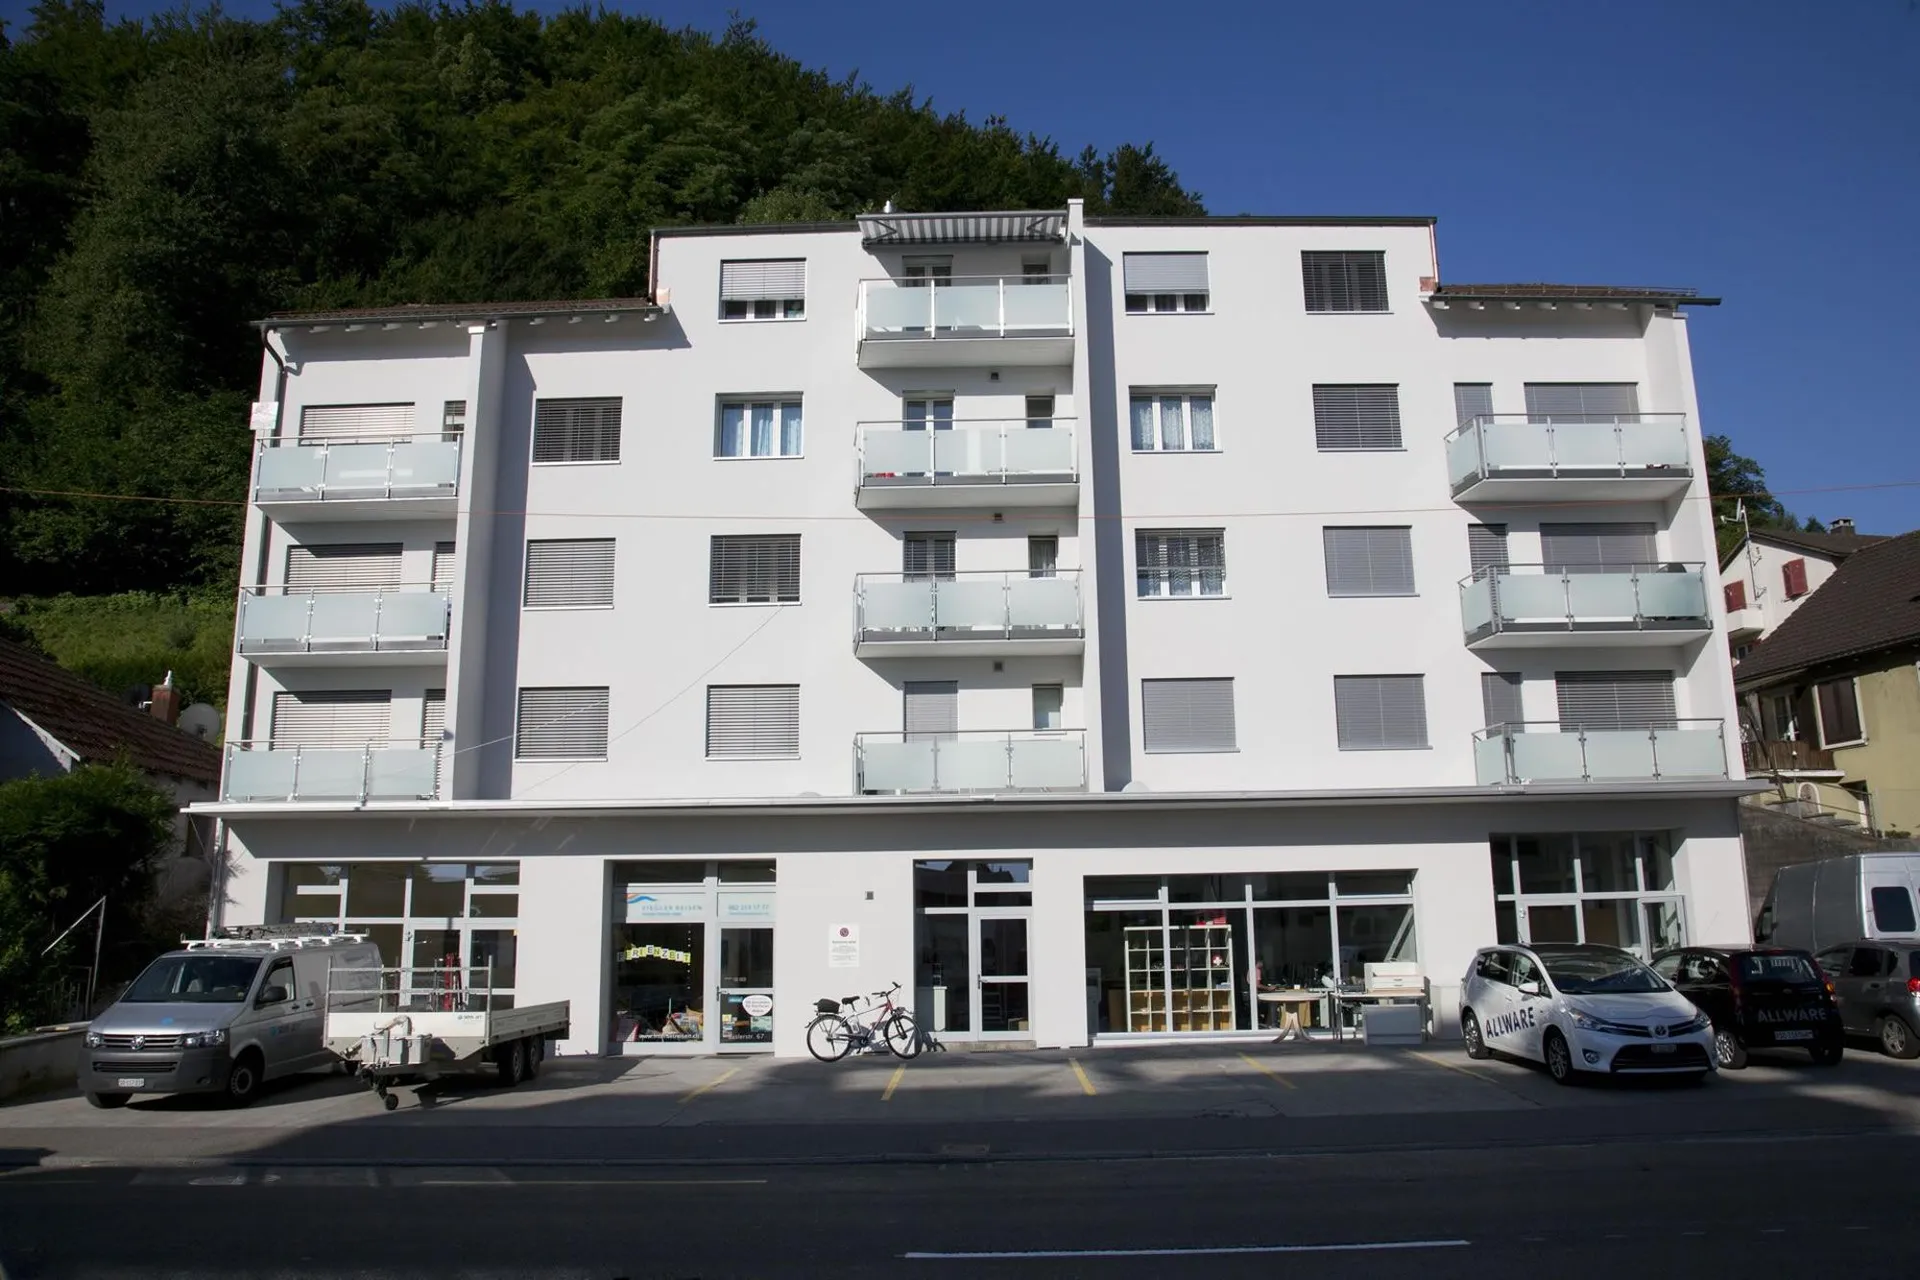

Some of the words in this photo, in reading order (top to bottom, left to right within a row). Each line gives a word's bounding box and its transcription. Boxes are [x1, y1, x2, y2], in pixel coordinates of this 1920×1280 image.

[618, 946, 690, 962] FERIENZEIT
[1485, 1006, 1535, 1038] ALLWARE
[1758, 1008, 1827, 1022] ALLWARE
